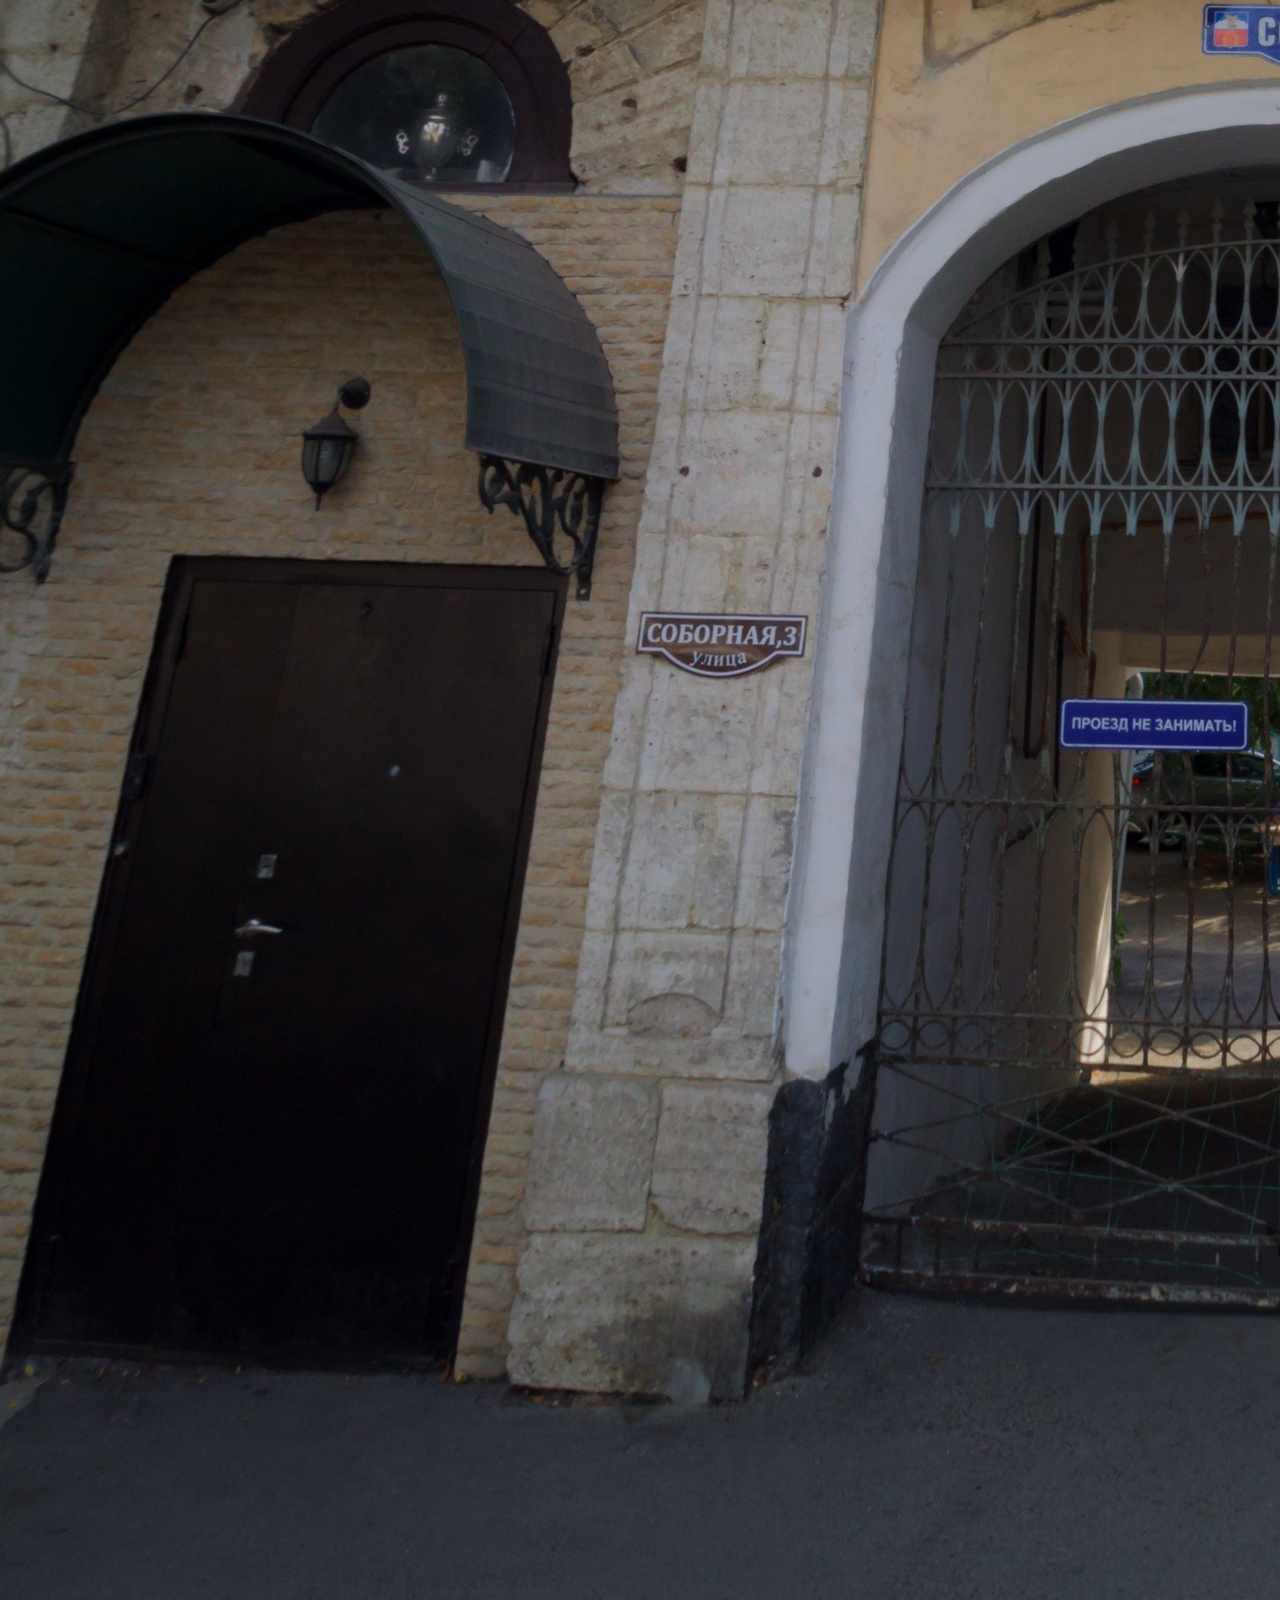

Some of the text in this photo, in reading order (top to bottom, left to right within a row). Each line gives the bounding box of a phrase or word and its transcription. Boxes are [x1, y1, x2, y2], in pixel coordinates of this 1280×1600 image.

[690, 651, 747, 667] улица
[1071, 717, 1236, 732] ПРОЕЗД НЕ ЗАНИМАТЬ!
